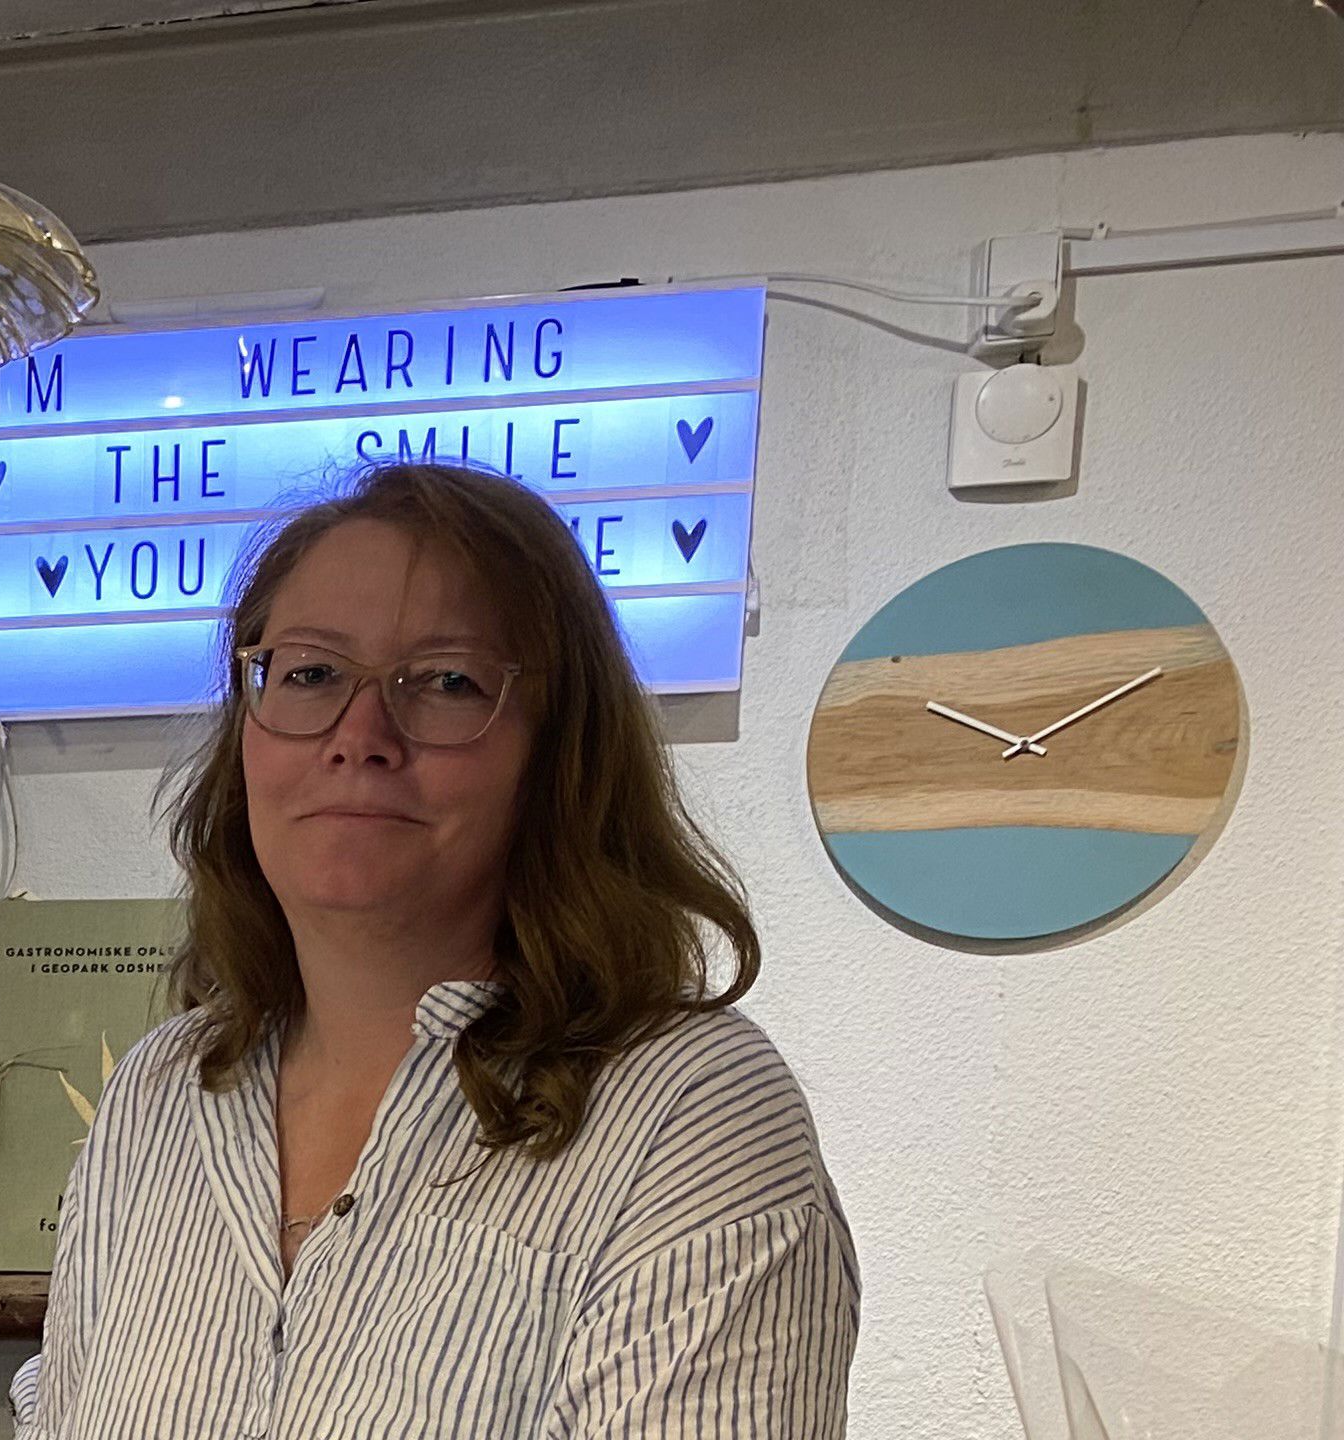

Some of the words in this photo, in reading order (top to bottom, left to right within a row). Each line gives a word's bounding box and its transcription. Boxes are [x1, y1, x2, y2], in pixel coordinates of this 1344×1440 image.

[240, 316, 565, 398] WEARING
[106, 439, 228, 505] THE
[85, 538, 207, 602] YOU
[5, 946, 132, 957] GASTRONOMISKE
[30, 964, 36, 974] I
[41, 963, 110, 974] GEOPARK
